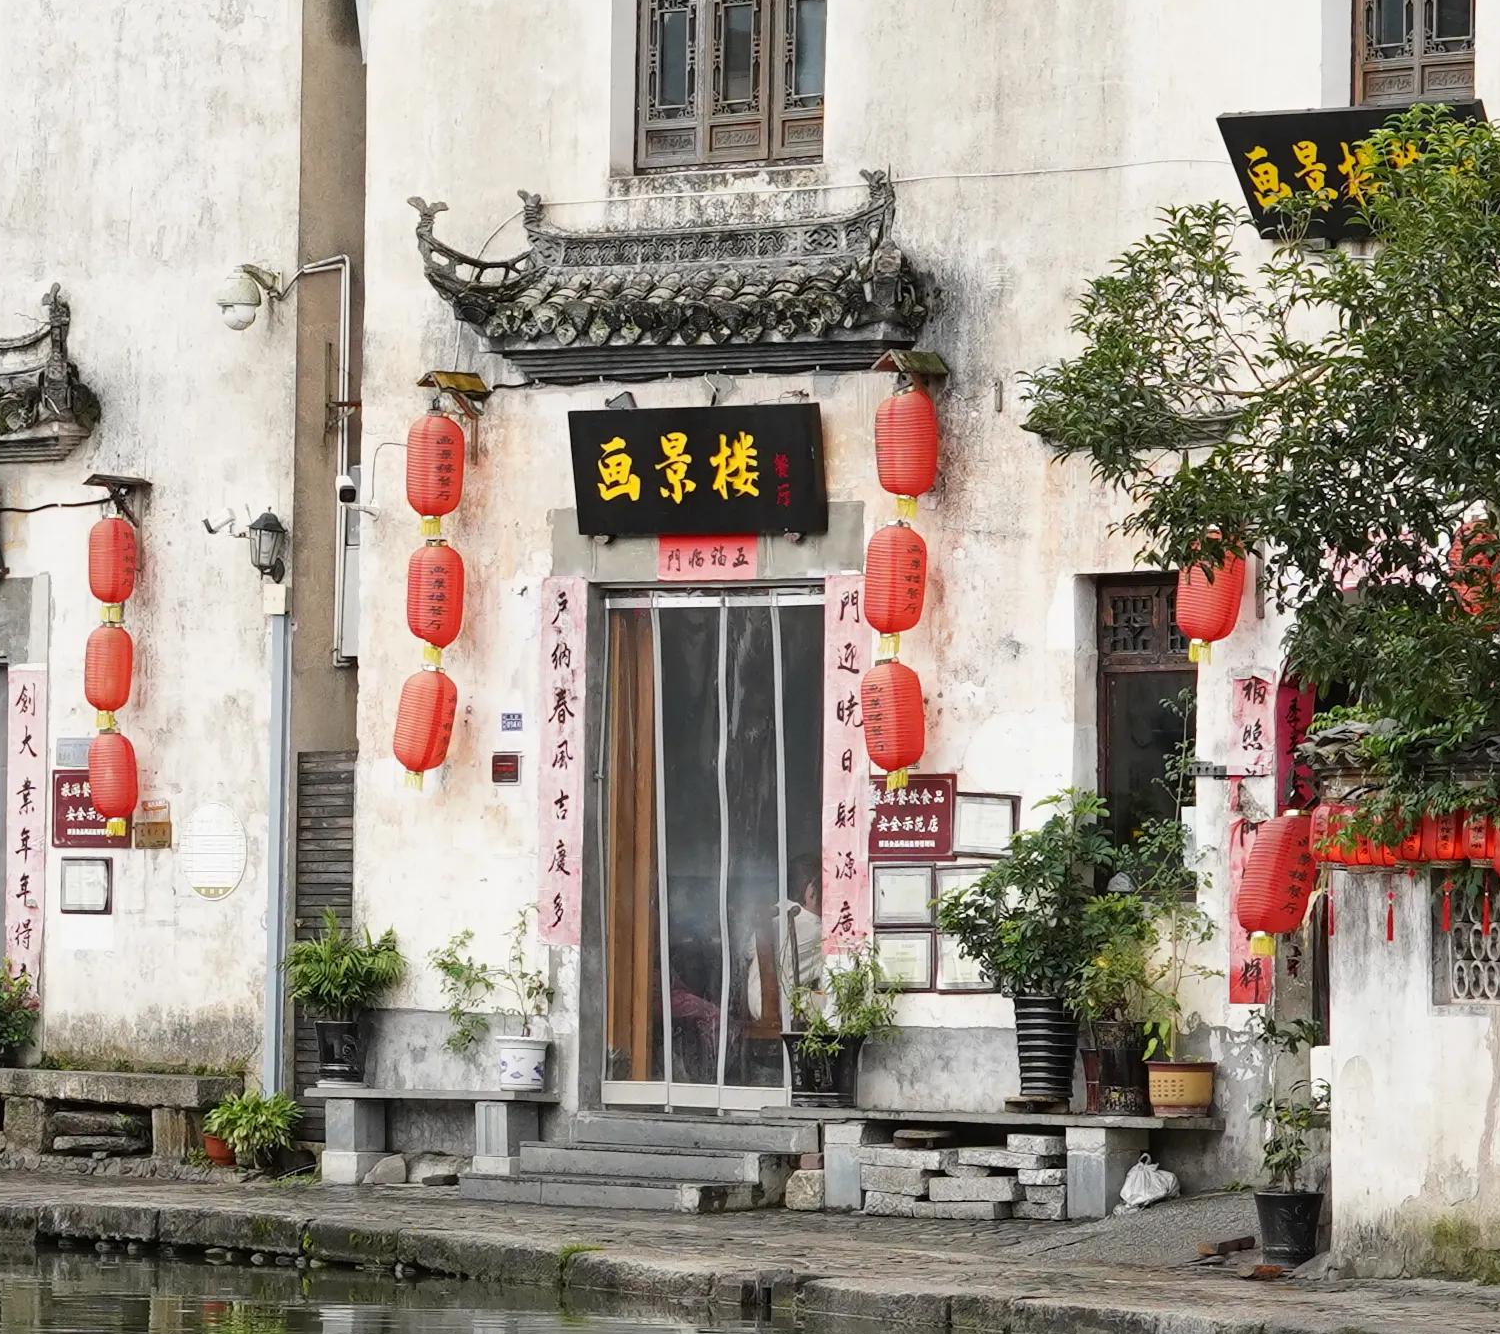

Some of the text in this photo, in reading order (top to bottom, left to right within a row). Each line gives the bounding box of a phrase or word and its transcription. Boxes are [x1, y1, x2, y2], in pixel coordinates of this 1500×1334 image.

[597, 431, 760, 504] 画景楼
[876, 815, 939, 833] 安全示范店
